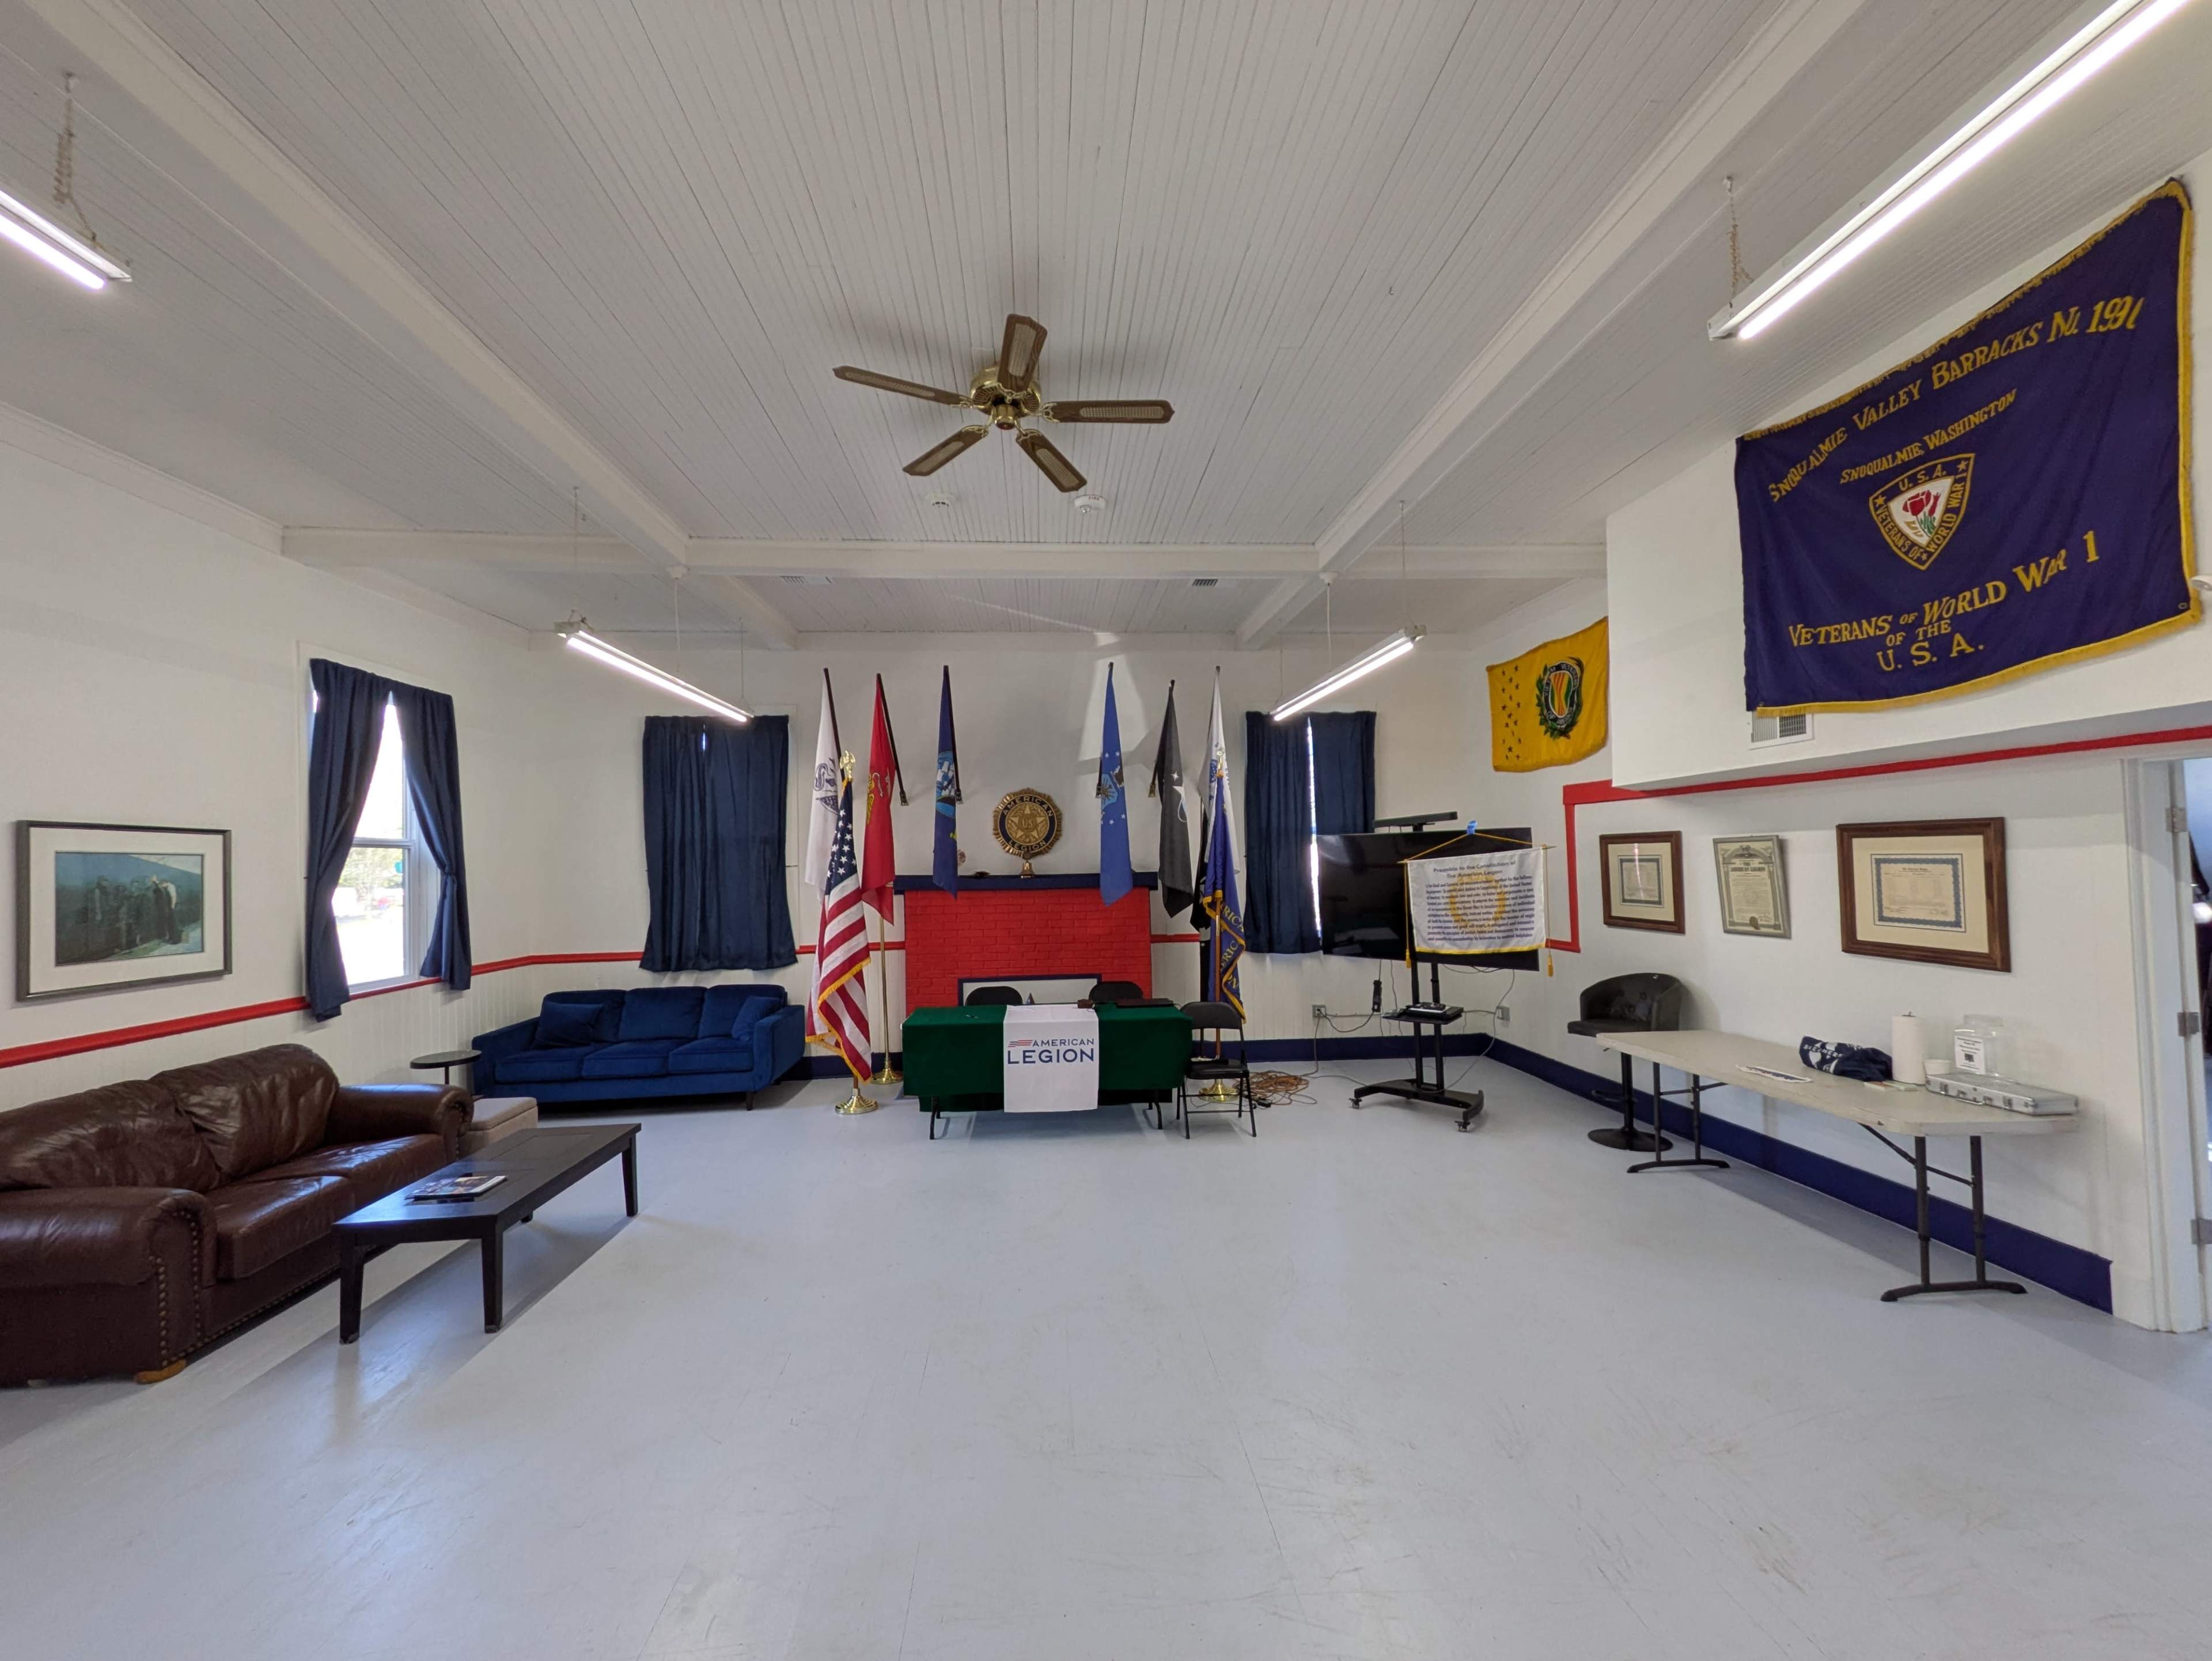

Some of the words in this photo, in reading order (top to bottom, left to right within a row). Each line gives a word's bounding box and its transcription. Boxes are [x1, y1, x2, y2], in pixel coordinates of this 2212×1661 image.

[1769, 427, 1847, 502] SNOQUALMIE
[1853, 379, 1922, 431] VALLEY
[1931, 321, 2043, 390] BARRACKS
[1922, 388, 2017, 450] WASHINGTON
[1876, 504, 1912, 552] VETERANS
[1908, 546, 1923, 560] OF
[1926, 513, 1957, 553] WORLD
[1947, 482, 1965, 508] WAR
[1789, 614, 1893, 647] VETERANS
[1923, 580, 2007, 625] WORLD
[2012, 548, 2068, 593] WAR
[1887, 632, 1906, 647] OF
[1915, 619, 1952, 641] THE
[1003, 795, 1054, 817] AMERICAN
[1022, 818, 1033, 828] US
[1009, 840, 1047, 851] LEGION
[1476, 861, 1509, 869] Constitution
[1032, 1038, 1094, 1047] AMERICAN
[1007, 1048, 1094, 1065] LEGION
